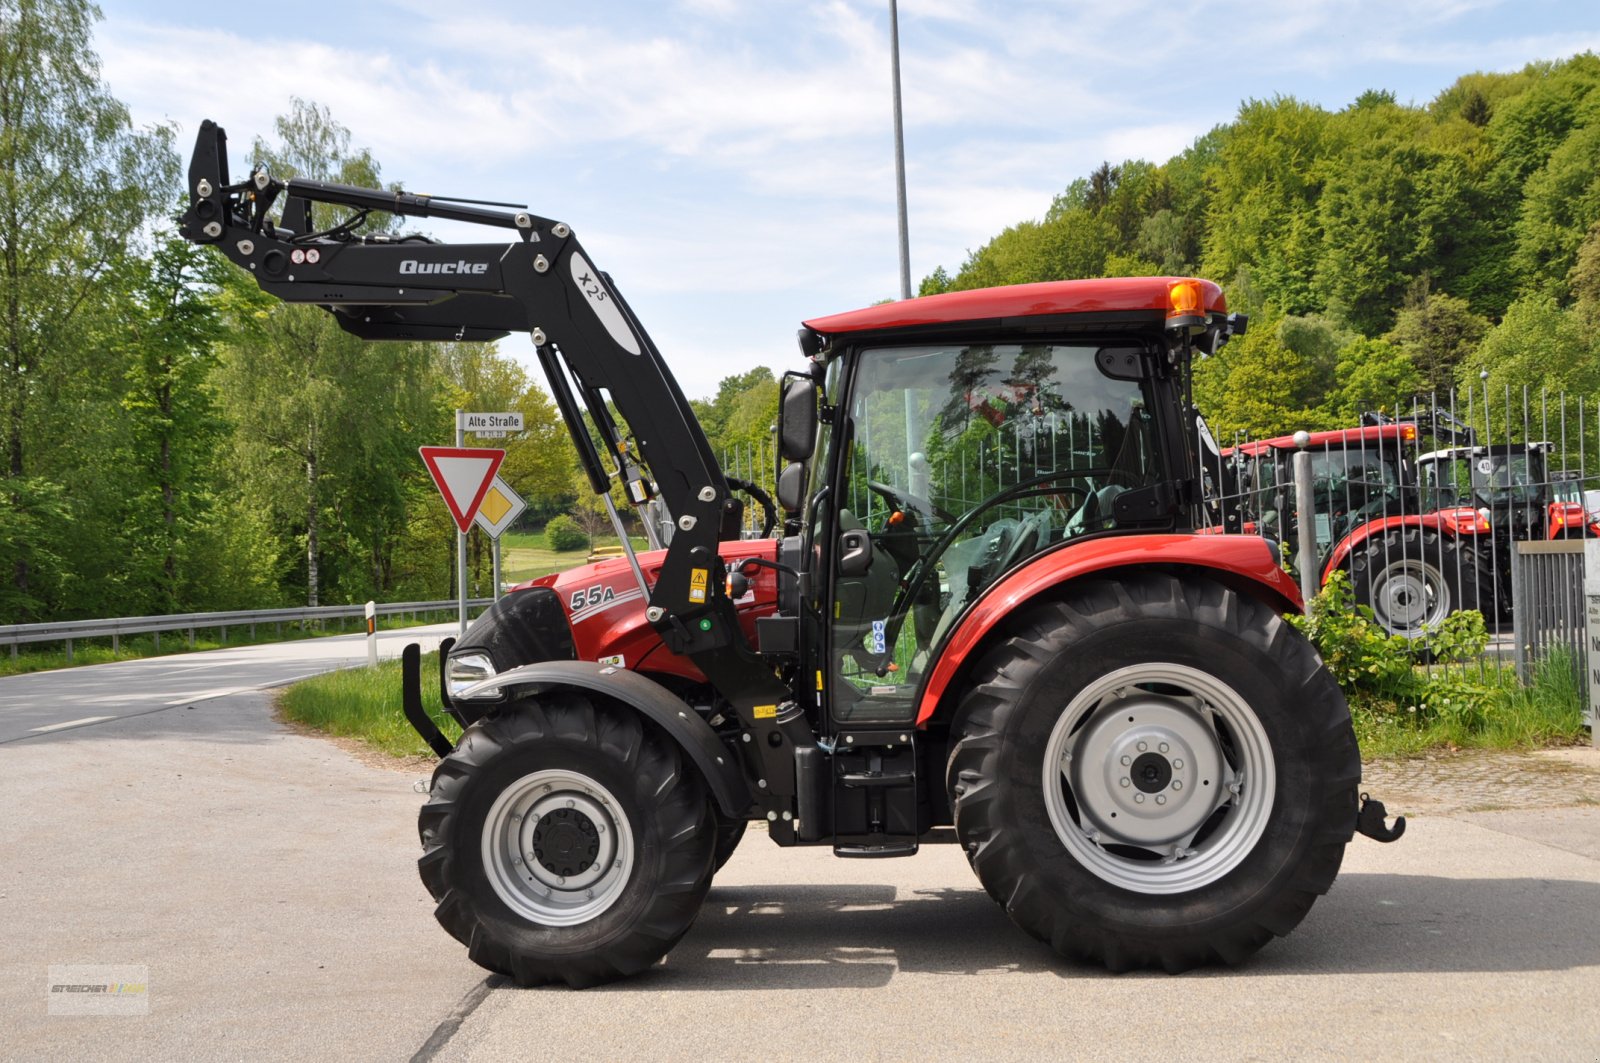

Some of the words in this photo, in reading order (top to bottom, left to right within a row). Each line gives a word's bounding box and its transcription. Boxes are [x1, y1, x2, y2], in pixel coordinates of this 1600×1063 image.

[399, 260, 488, 274] Quicke
[468, 416, 487, 427] Alte
[489, 415, 520, 427] Straße
[570, 584, 615, 611] 55A
